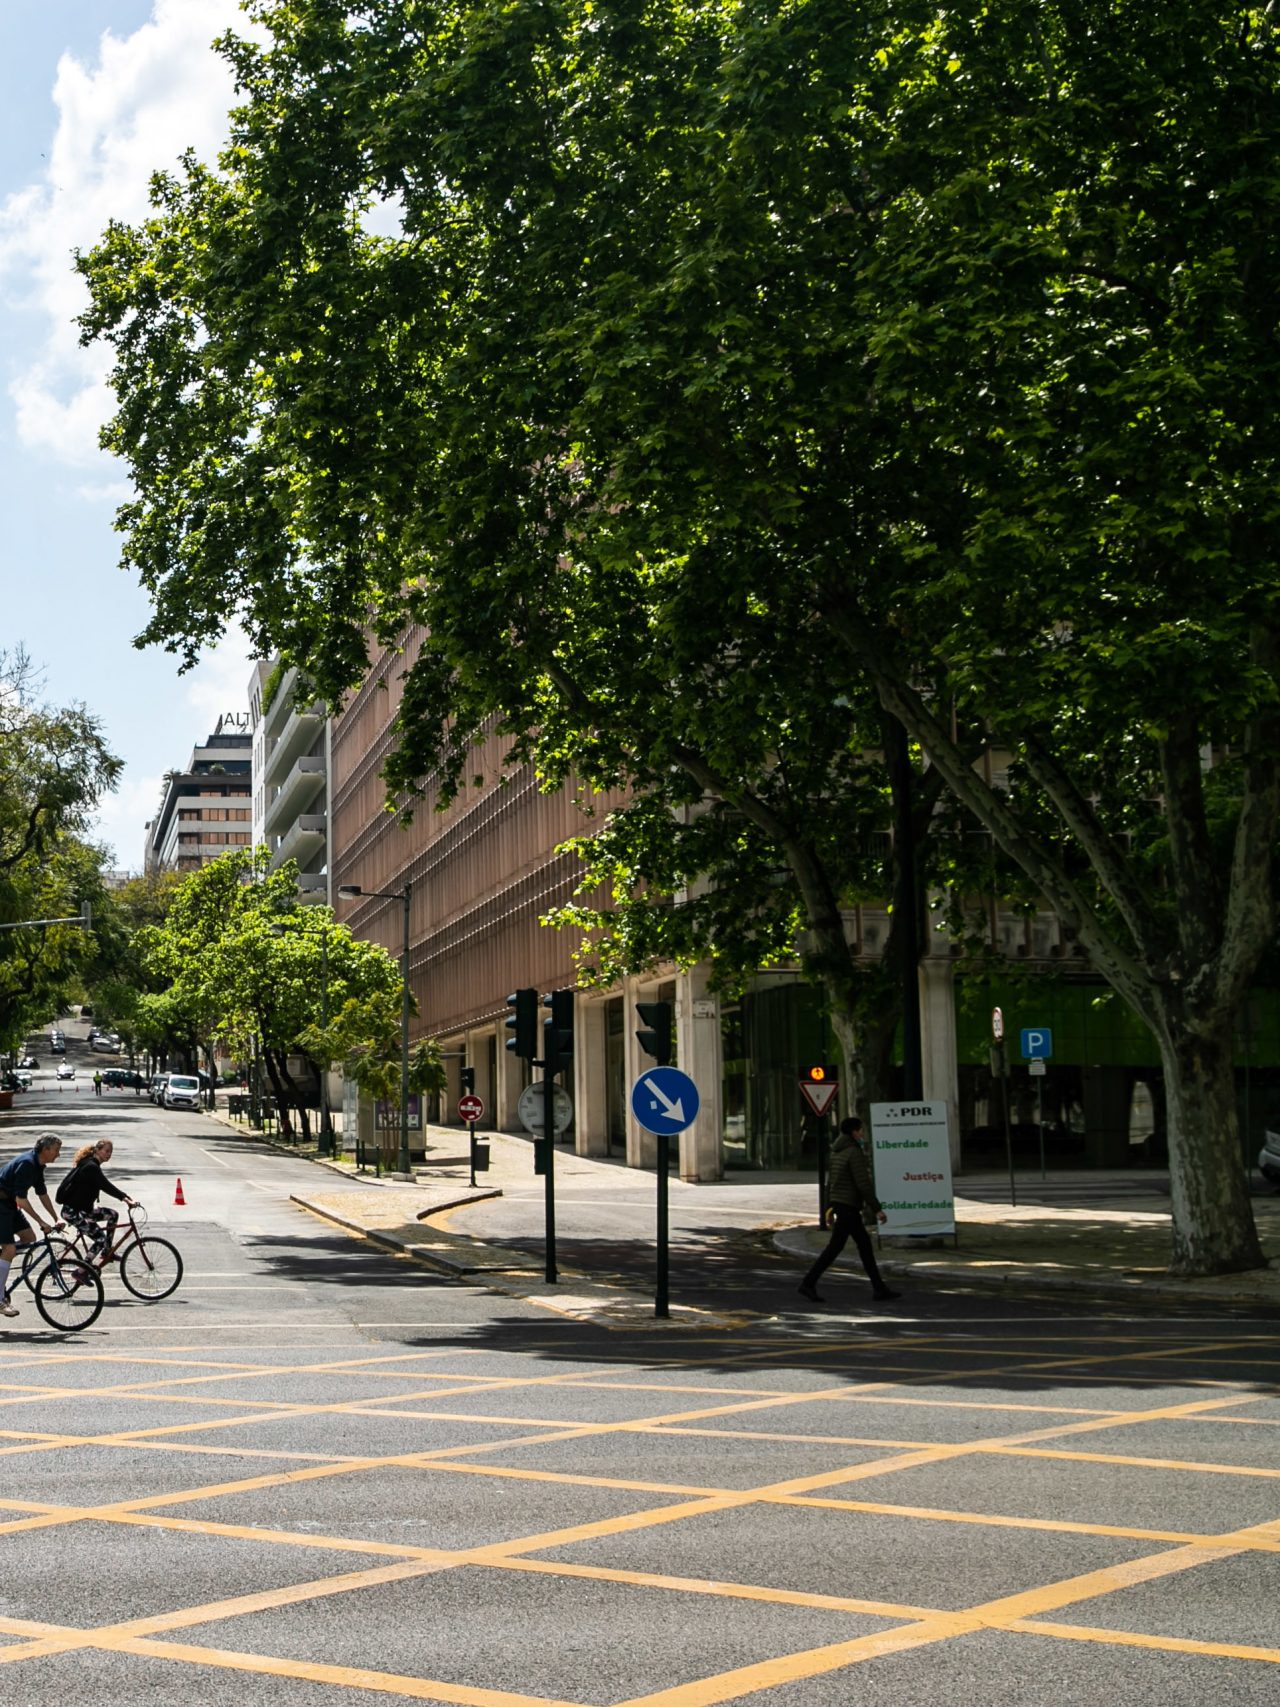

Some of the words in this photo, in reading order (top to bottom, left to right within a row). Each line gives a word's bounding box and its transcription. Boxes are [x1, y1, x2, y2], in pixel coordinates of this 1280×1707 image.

[1029, 1033, 1043, 1053] P
[900, 1107, 933, 1117] PDR
[876, 1139, 929, 1149] Liberdade
[903, 1172, 944, 1182] Justiça
[880, 1200, 953, 1211] Solidariedade
